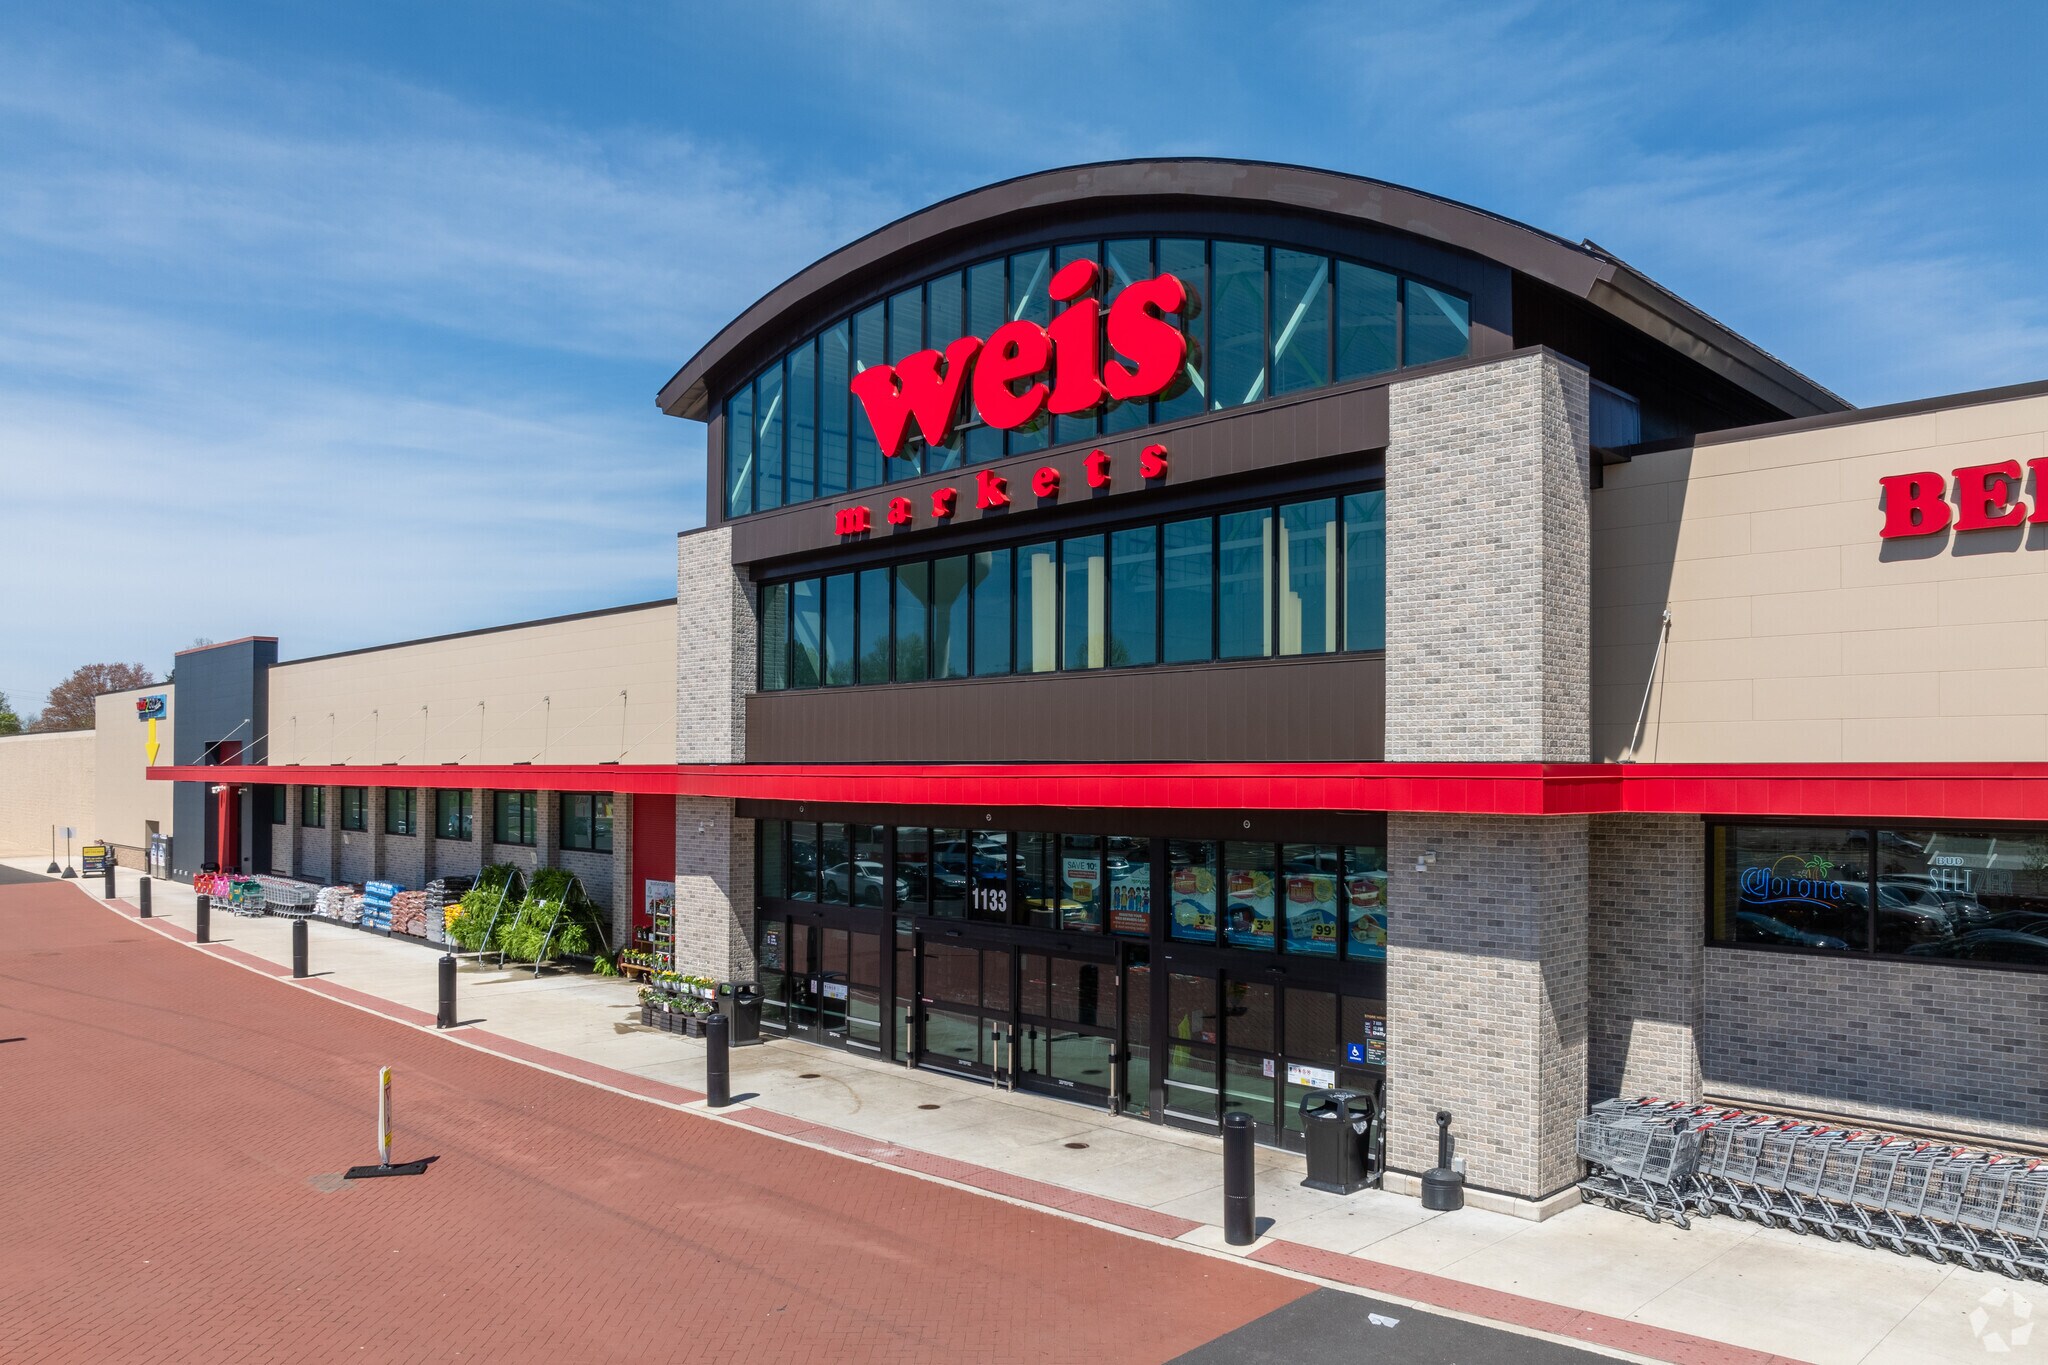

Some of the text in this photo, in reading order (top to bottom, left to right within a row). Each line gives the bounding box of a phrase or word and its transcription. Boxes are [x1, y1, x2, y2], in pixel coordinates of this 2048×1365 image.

[850, 258, 1187, 458] weis
[835, 444, 1168, 536] markets
[1879, 457, 2048, 539] BE
[1067, 861, 1085, 870] SAVE
[1936, 856, 1964, 866] BUD
[1740, 867, 1845, 900] Corona
[1928, 867, 2014, 896] SELTZER
[972, 888, 1007, 912] 1133
